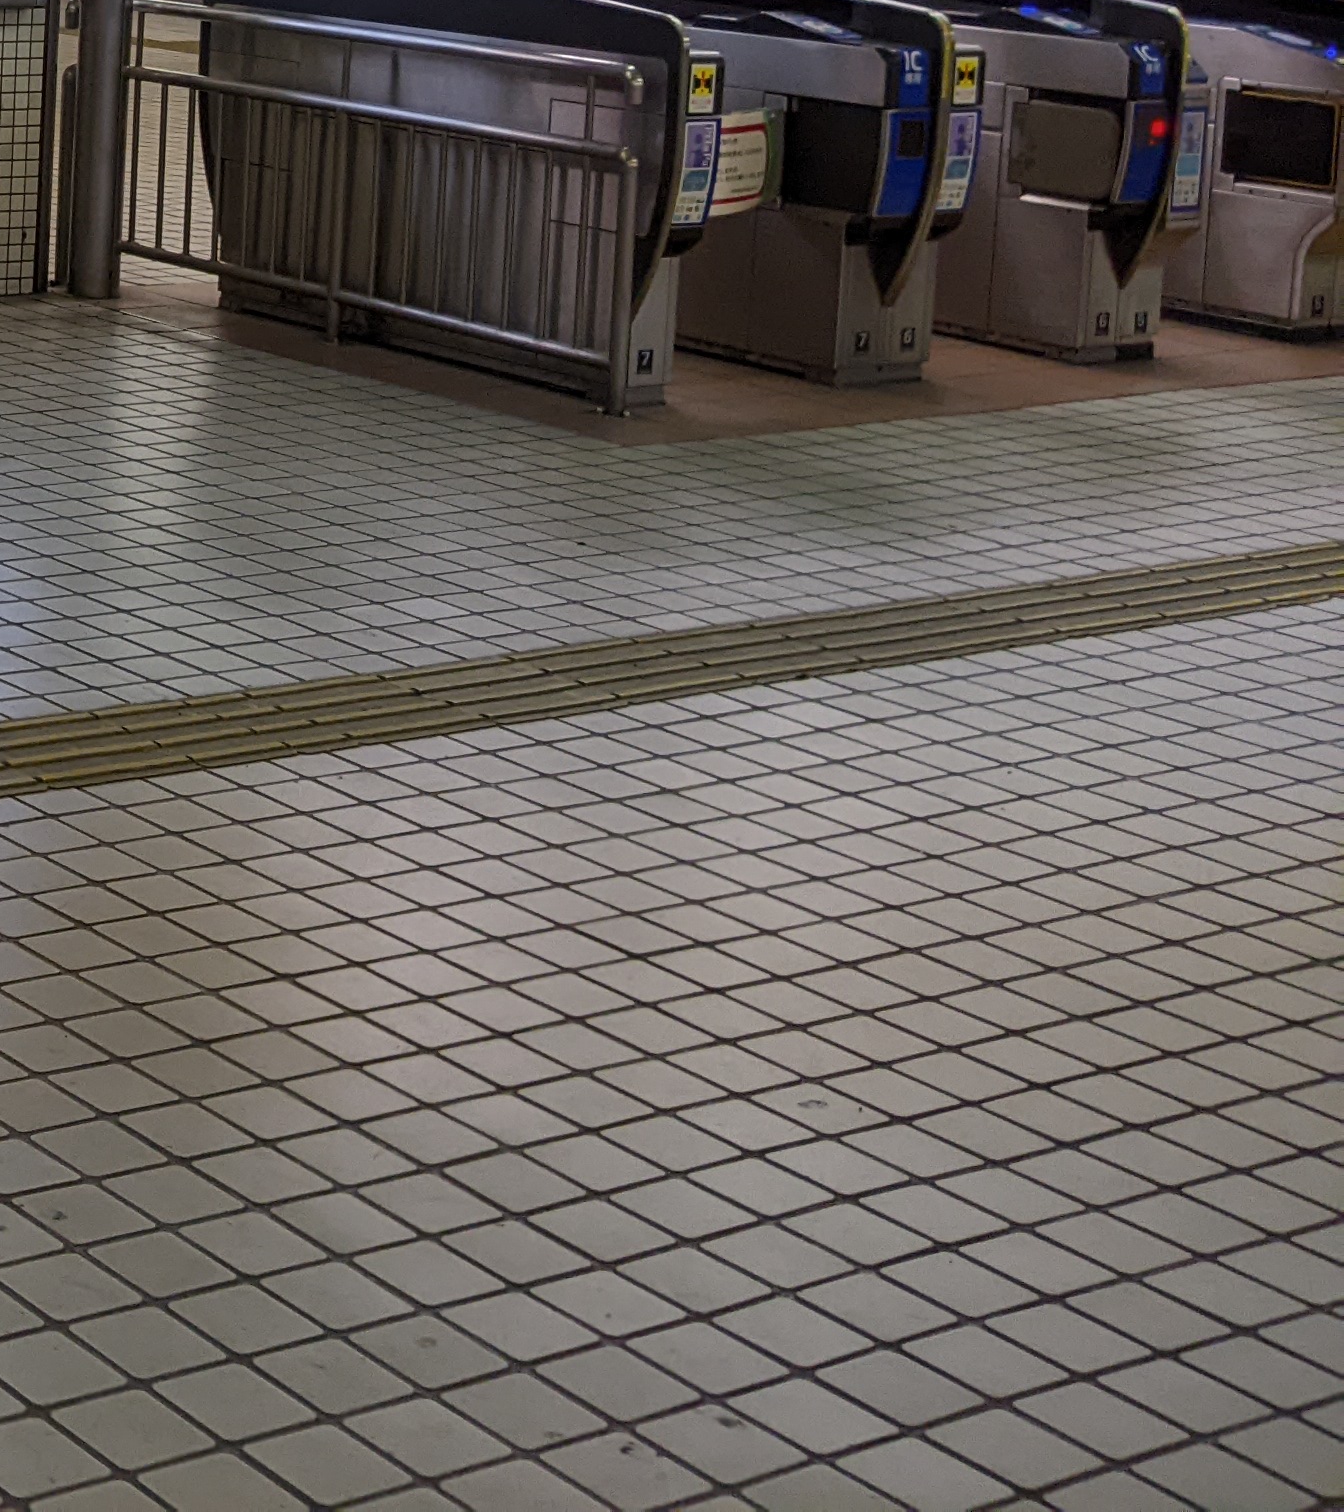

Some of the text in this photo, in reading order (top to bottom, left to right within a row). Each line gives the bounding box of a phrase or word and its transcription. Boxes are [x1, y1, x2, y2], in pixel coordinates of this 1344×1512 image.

[903, 50, 923, 71] IC
[1133, 45, 1159, 62] IC
[641, 351, 650, 366] 7
